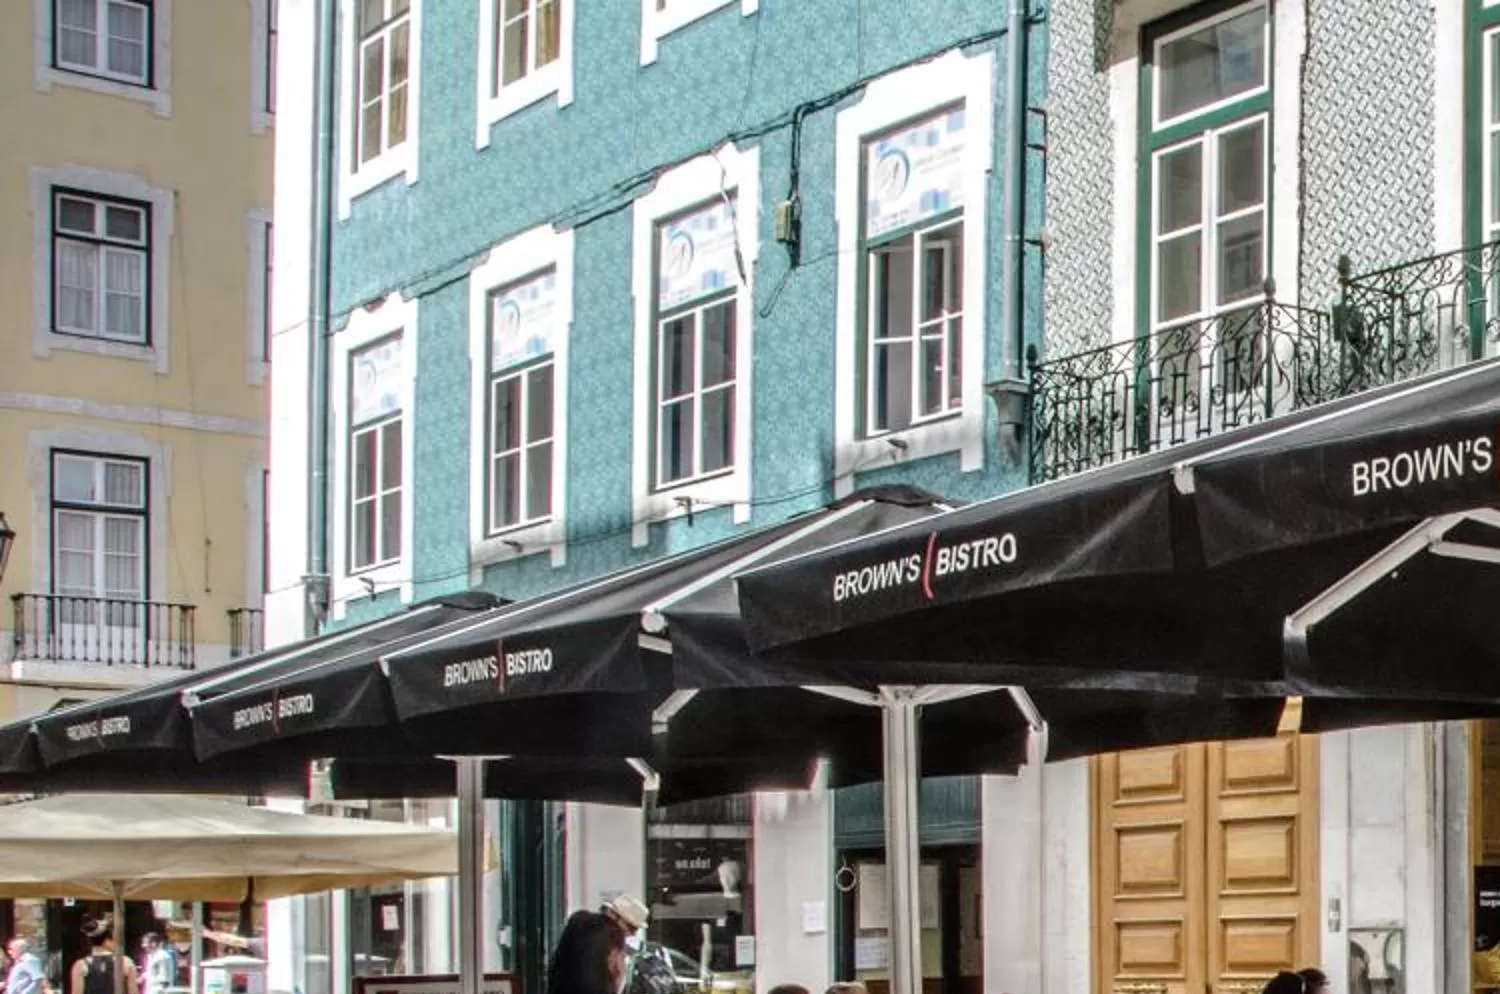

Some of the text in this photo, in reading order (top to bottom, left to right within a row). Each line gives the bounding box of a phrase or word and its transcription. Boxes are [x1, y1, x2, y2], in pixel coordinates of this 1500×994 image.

[1352, 436, 1494, 496] BROWN'S
[833, 532, 1018, 602] BROWN'S BISTRO
[443, 647, 553, 688] BROWN'S BISTRO
[278, 693, 313, 718] BISTRO
